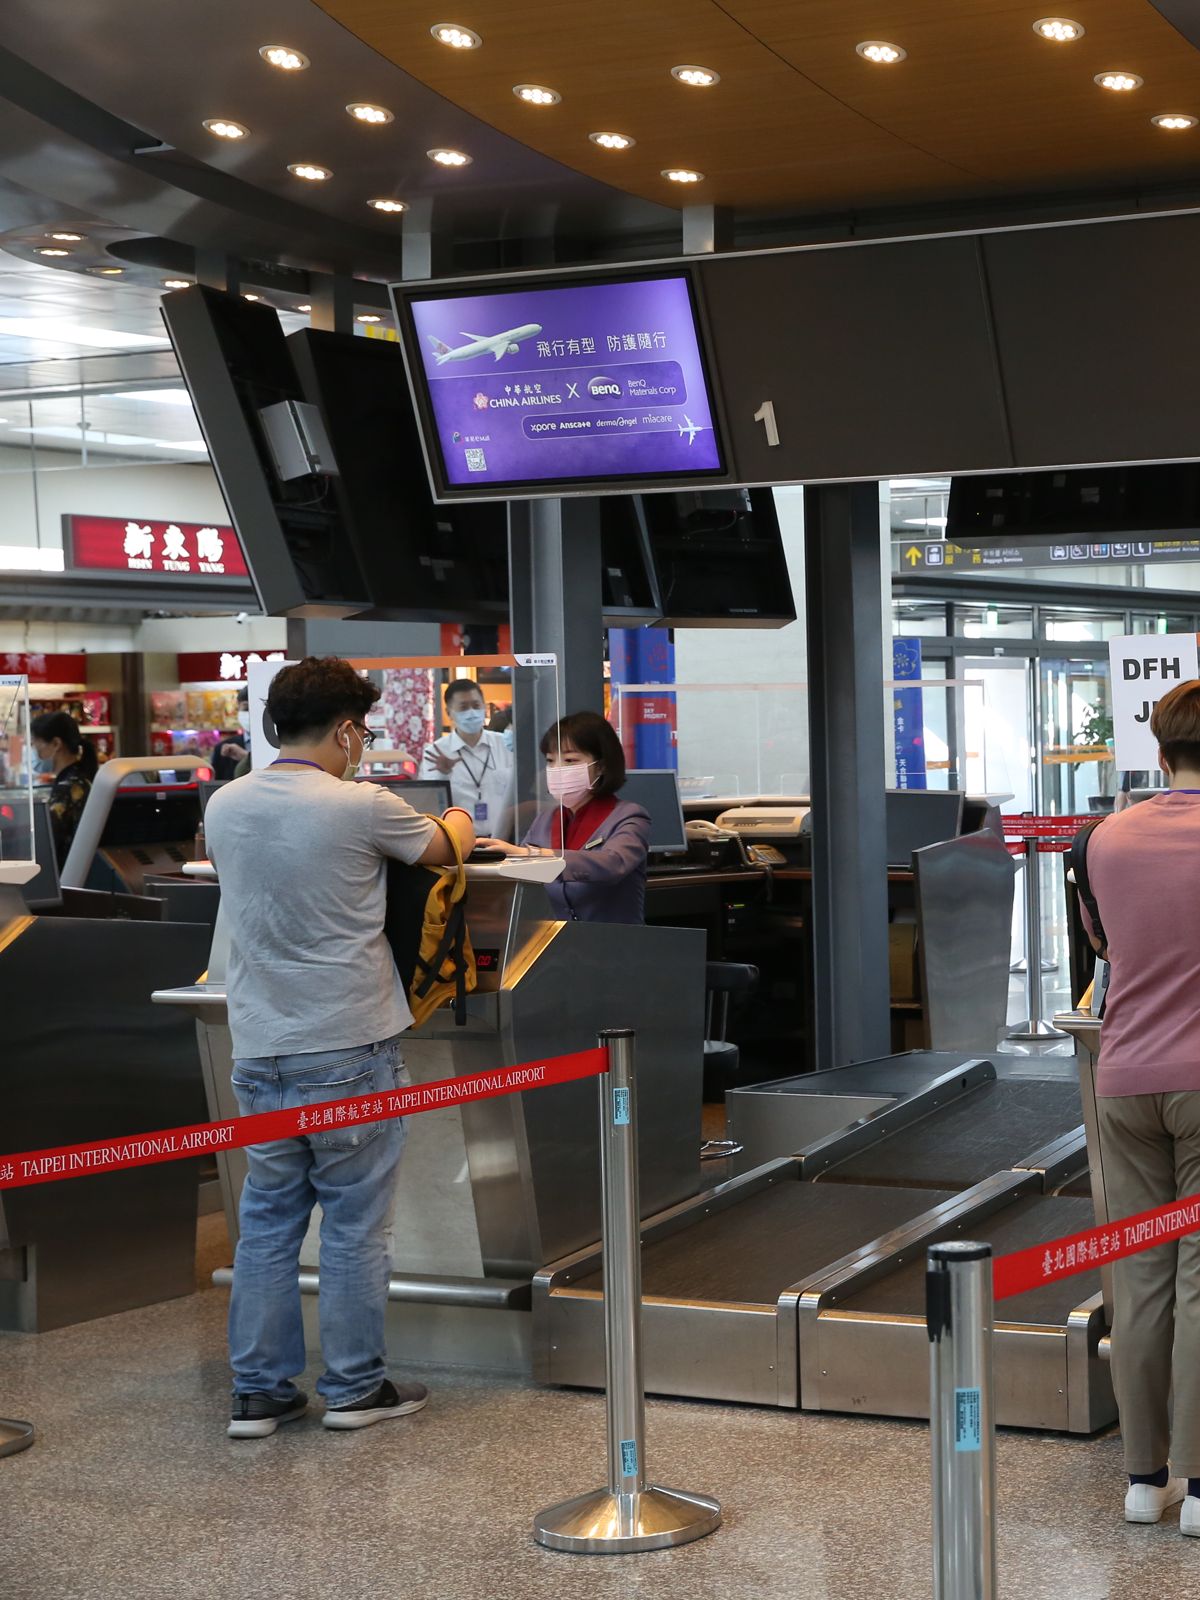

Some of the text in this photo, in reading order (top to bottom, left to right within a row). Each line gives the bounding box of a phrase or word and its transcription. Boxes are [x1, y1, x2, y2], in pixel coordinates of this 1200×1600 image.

[489, 394, 562, 409] CHINA AIRLINES
[591, 383, 621, 396] BenQ
[530, 422, 557, 433] xpore
[754, 400, 780, 447] 1
[1123, 657, 1181, 681] DFH
[1134, 701, 1159, 723] J
[297, 1065, 547, 1131] 臺北國際航空站 TAIPEI INTERNATIONAL AIRPORT
[21, 1155, 66, 1178] TAIPEI
[69, 1136, 179, 1171] INTERNATIONAL
[180, 1126, 235, 1153] AIRPORT
[1124, 1221, 1155, 1248] TAIPEI
